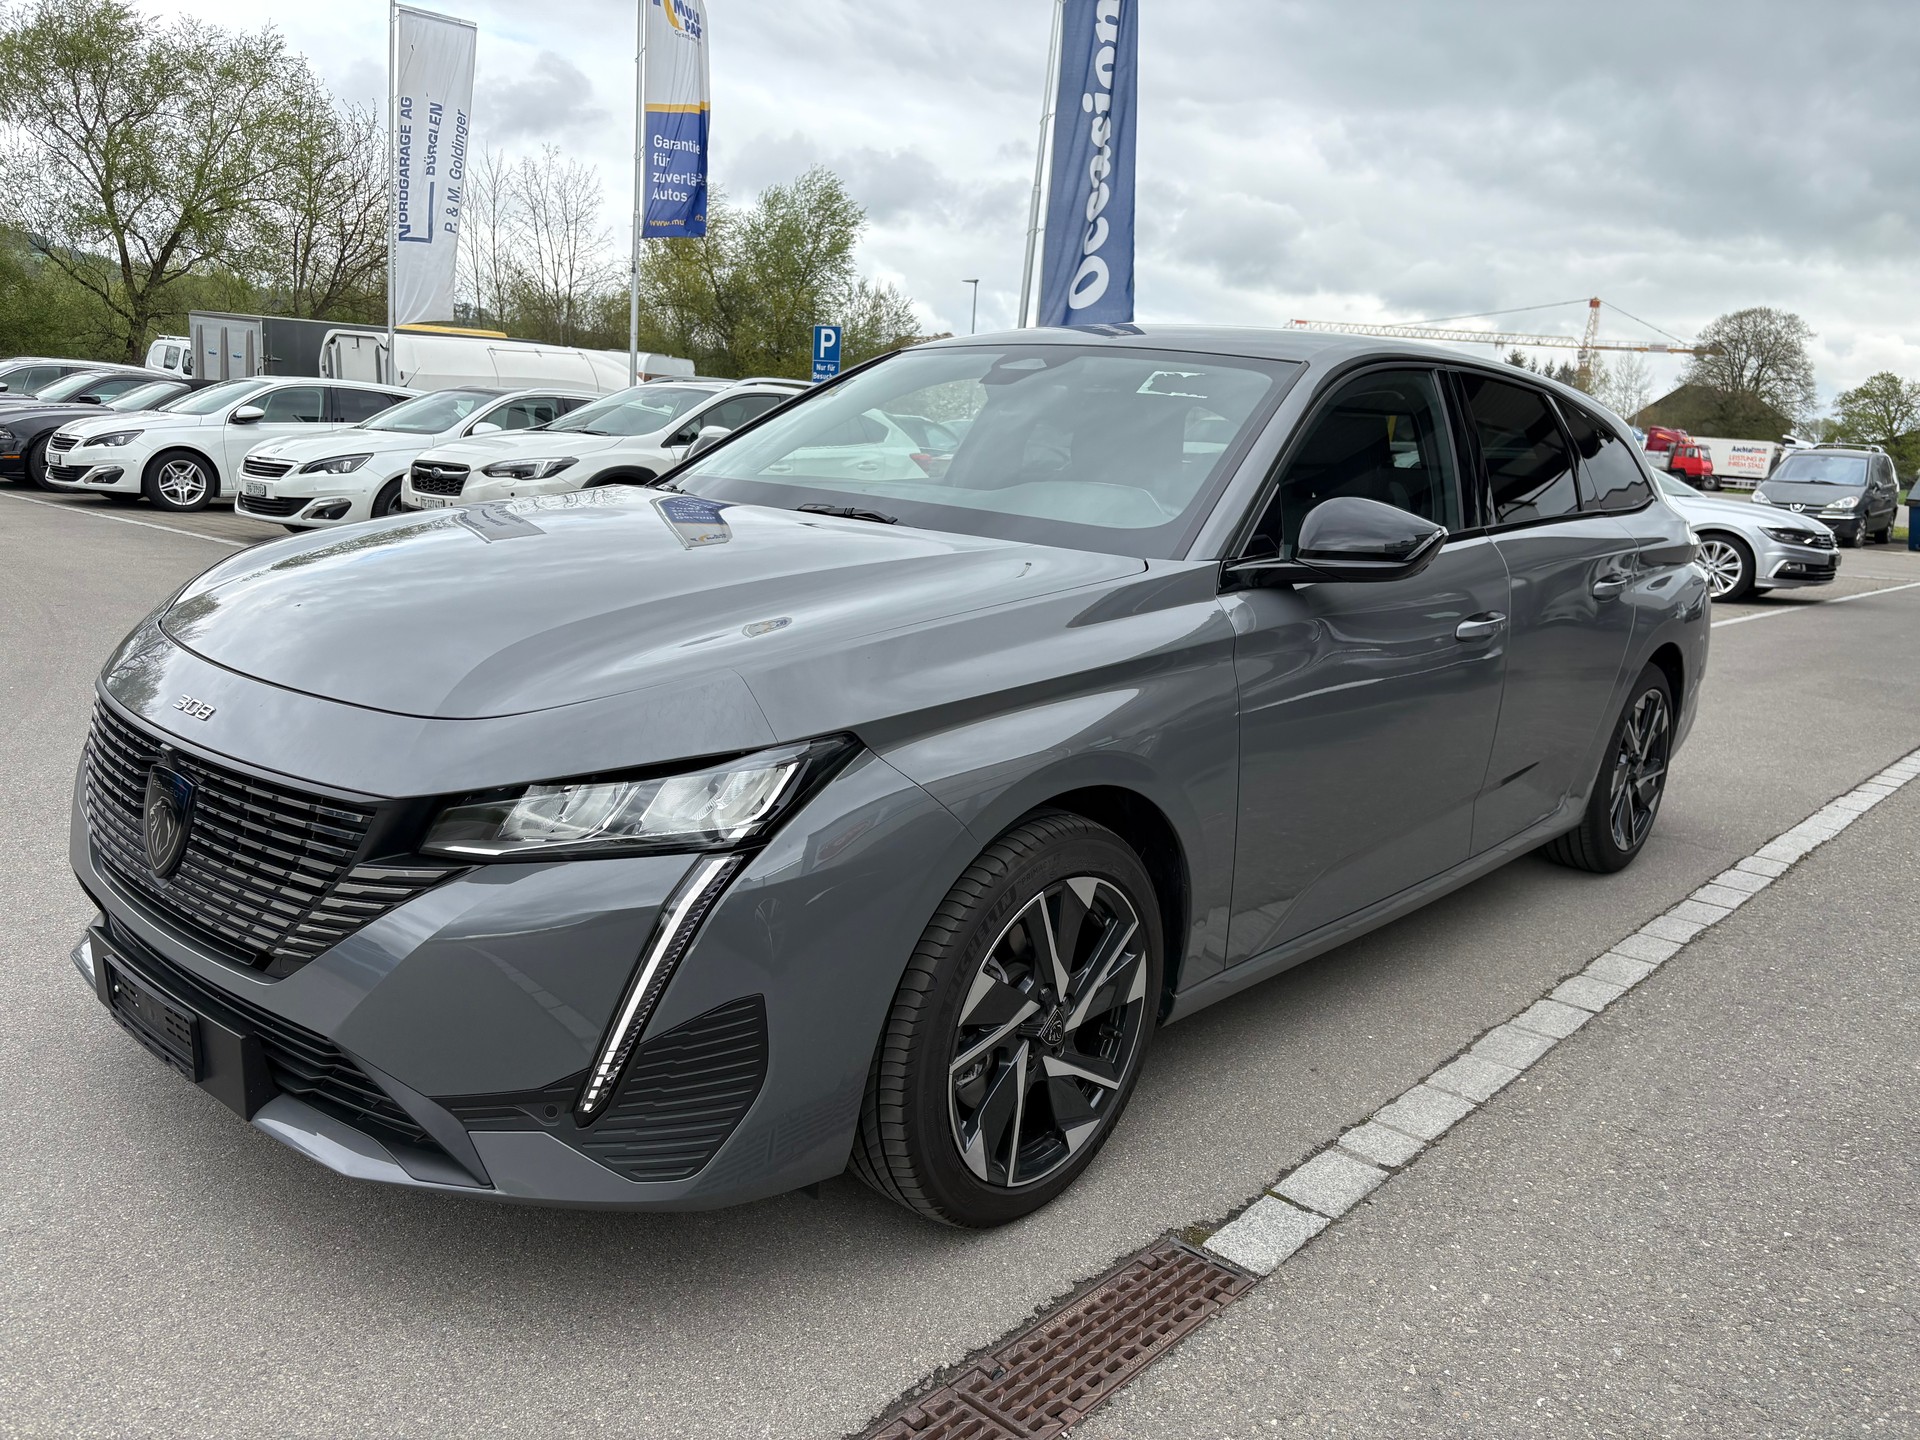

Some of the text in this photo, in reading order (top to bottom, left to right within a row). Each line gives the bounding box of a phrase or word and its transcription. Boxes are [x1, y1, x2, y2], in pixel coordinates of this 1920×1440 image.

[449, 109, 468, 181] Goldinger
[653, 134, 700, 154] Garantie
[398, 96, 413, 241] NORDGARAGE AG
[653, 152, 671, 167] für
[447, 186, 461, 204] M.
[651, 187, 688, 202] Autos
[446, 207, 459, 218] &
[820, 328, 836, 358] P
[816, 363, 836, 371] Nur für
[172, 694, 216, 721] 308
